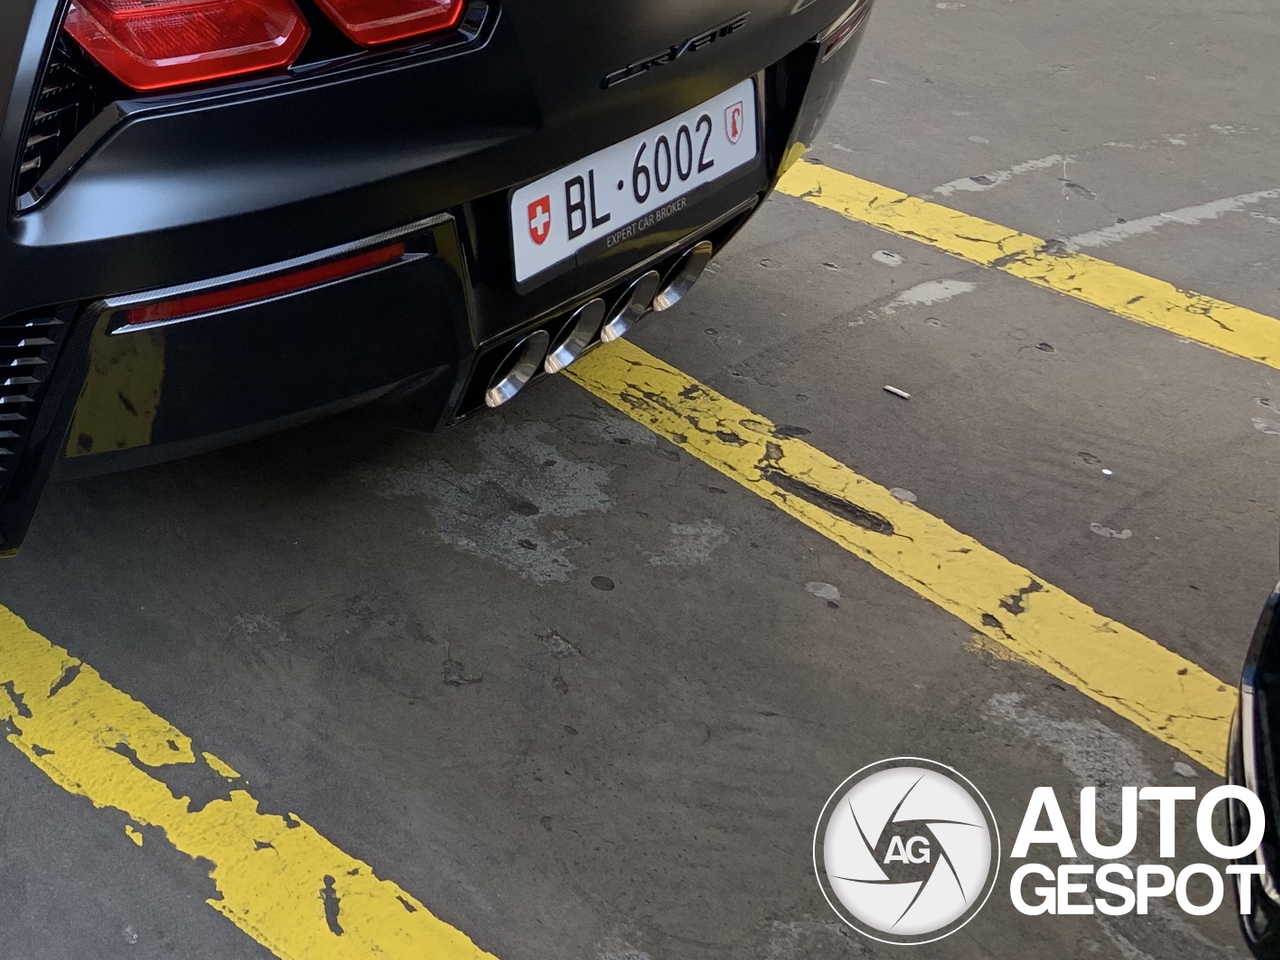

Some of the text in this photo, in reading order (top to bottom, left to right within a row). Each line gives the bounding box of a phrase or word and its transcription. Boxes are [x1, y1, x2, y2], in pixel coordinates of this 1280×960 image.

[606, 196, 687, 248] EXPERT CAR BROKER
